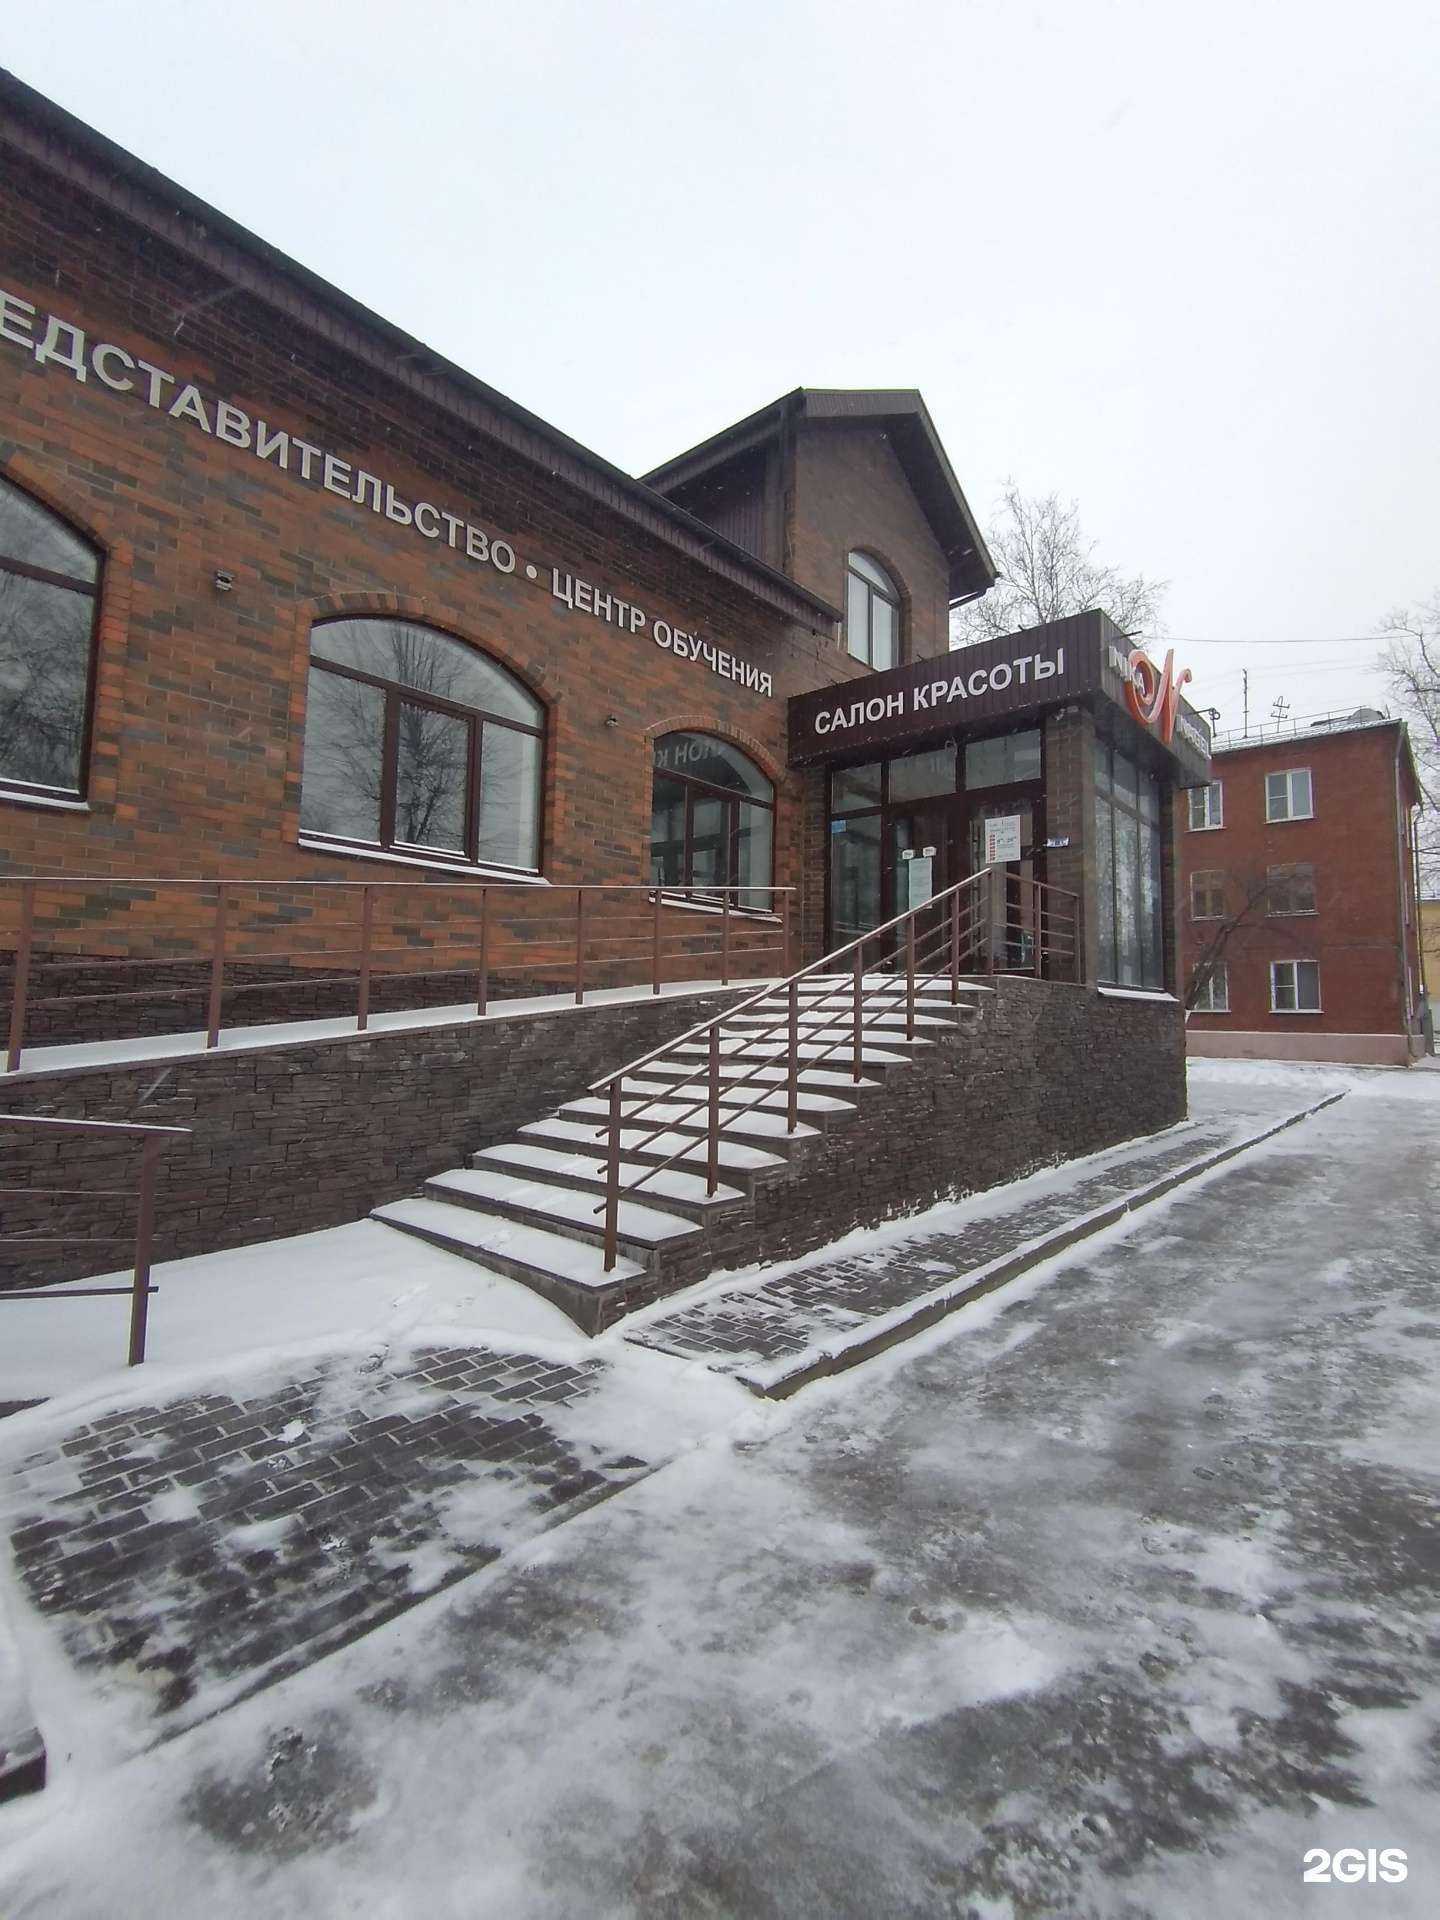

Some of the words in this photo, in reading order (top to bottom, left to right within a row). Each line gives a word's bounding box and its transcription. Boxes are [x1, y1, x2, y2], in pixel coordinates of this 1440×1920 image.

[0, 289, 516, 574] ЕДСТАВИТЕЛЬСТВО
[552, 567, 646, 633] ЦЕНТР
[653, 620, 773, 697] ОБУЧЕНИЯ
[814, 692, 904, 735] САЛОН
[913, 648, 1064, 711] КРАСОТЫ
